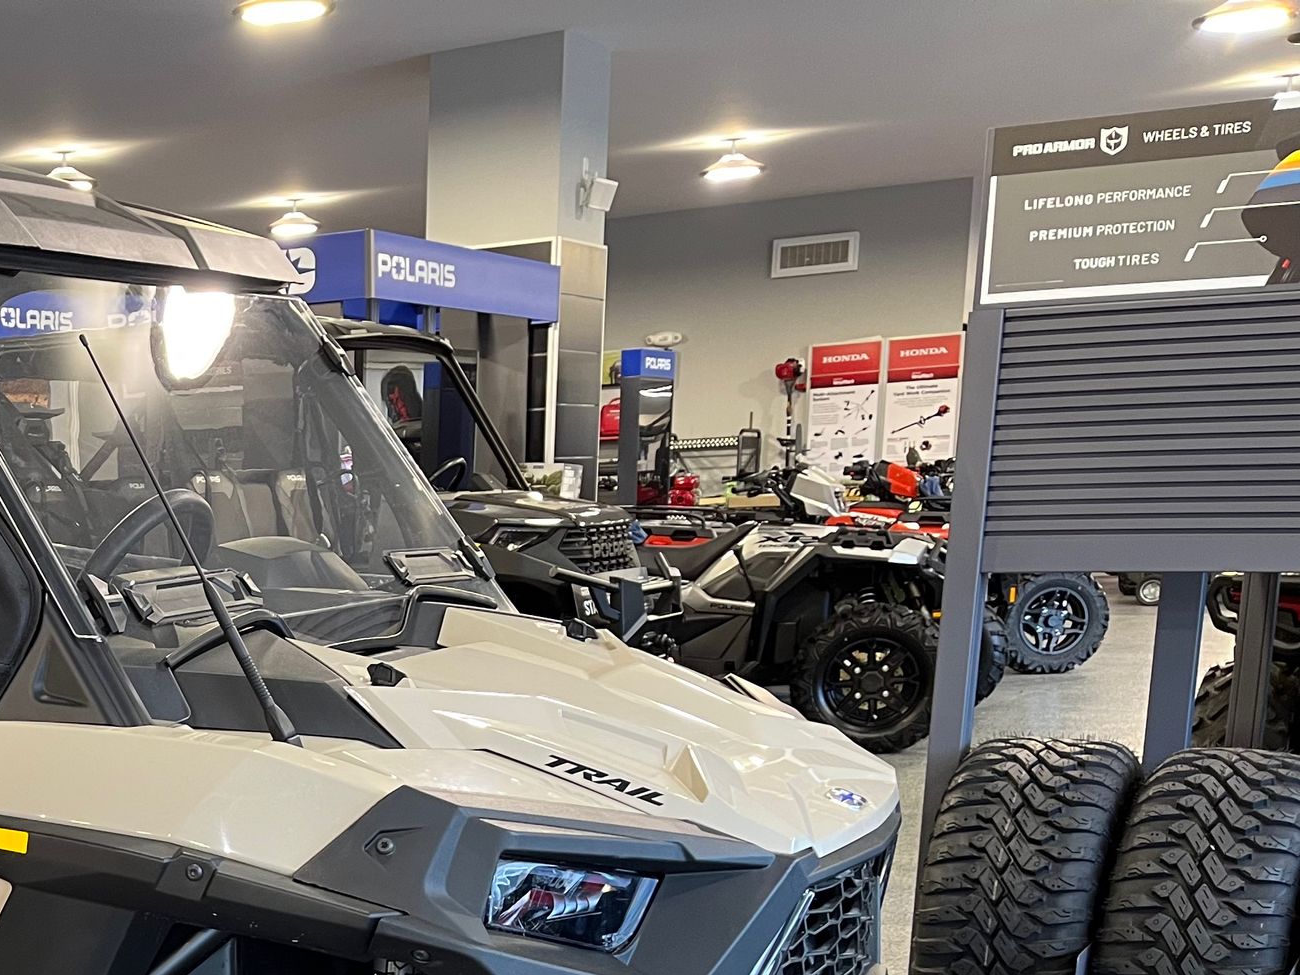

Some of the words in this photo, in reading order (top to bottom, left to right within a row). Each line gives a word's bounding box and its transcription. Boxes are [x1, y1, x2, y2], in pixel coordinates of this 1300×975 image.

[1142, 127, 1198, 144] WHEELS
[1200, 124, 1210, 138] &
[1213, 120, 1252, 136] TIRES
[1024, 193, 1093, 211] LIFELONG
[1096, 185, 1192, 204] PERFORMANCE
[1029, 225, 1093, 242] PREMIUM
[1096, 219, 1175, 236] PROTECTION
[377, 252, 456, 288] POLARIS
[1073, 256, 1116, 271] TOUGH
[1117, 253, 1160, 268] TIRES
[645, 356, 672, 371] POLARIS
[822, 353, 870, 364] HONDA
[900, 346, 949, 358] HONDA
[544, 754, 665, 806] TRAIL
